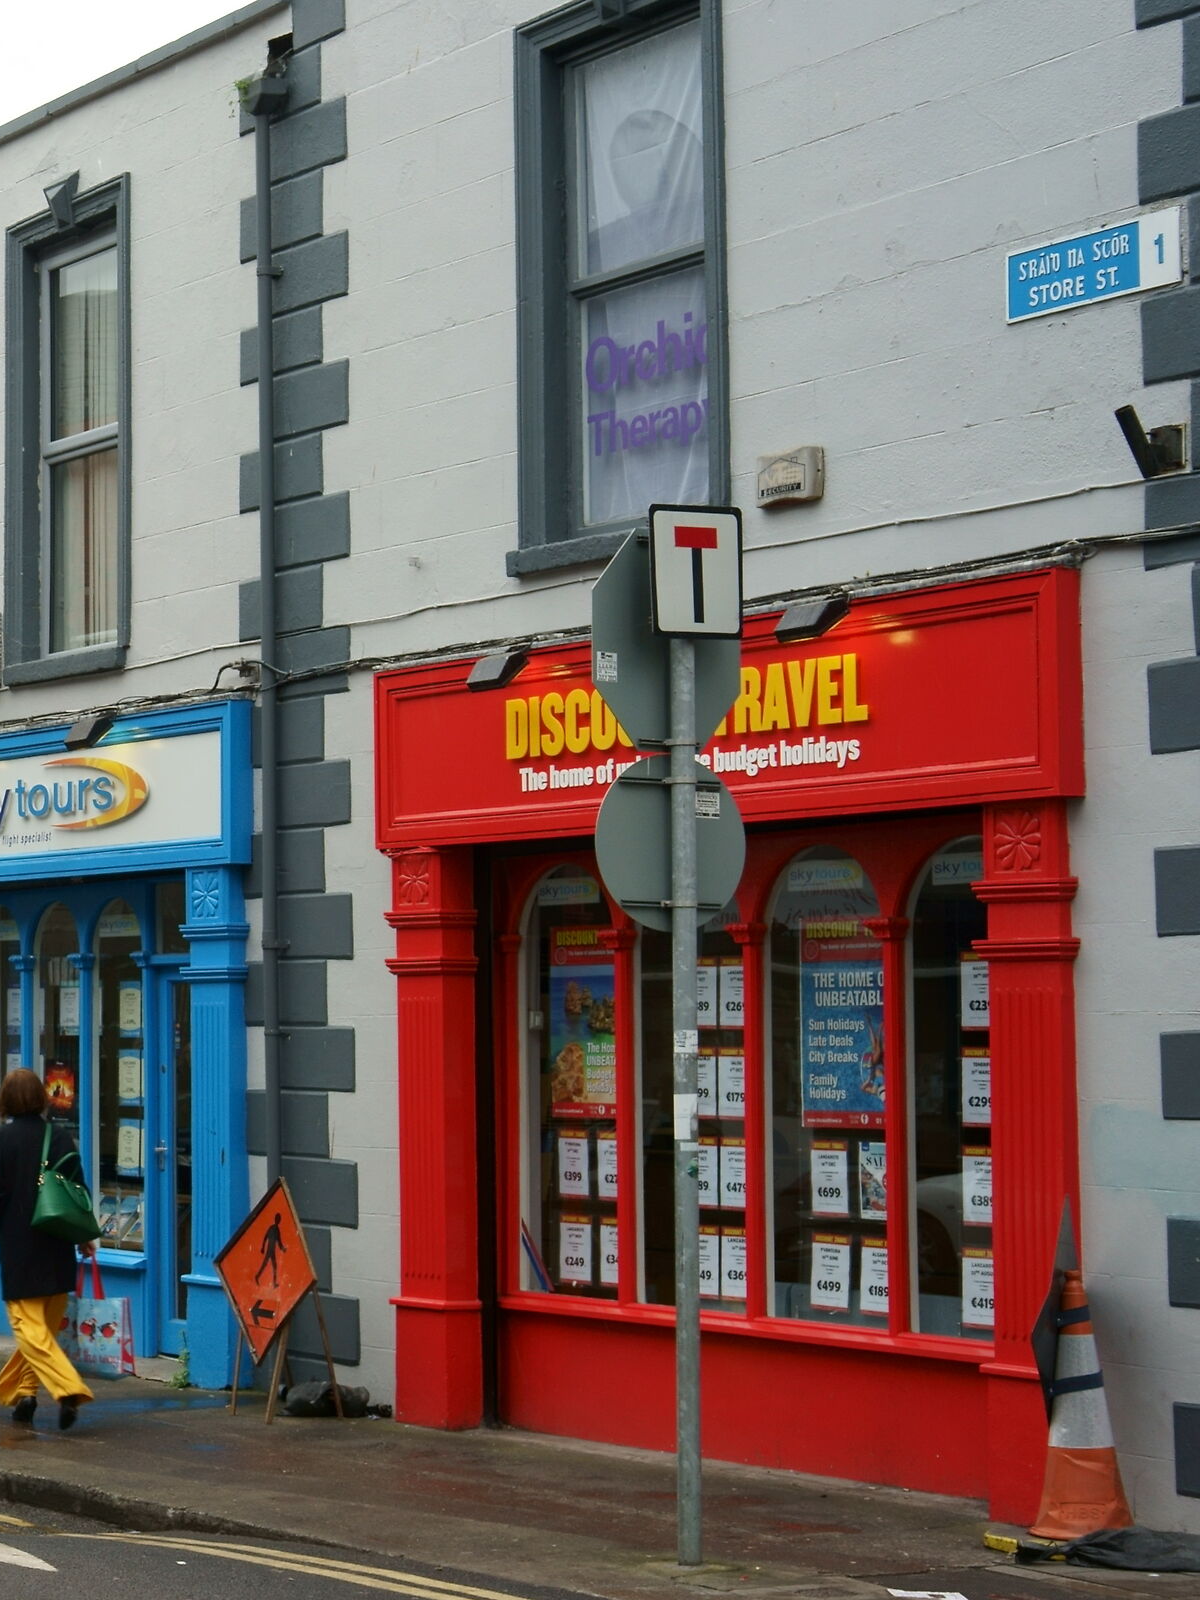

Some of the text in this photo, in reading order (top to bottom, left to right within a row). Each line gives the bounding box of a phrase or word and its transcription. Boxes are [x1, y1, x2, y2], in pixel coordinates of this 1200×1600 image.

[1154, 233, 1164, 264] 1
[1029, 266, 1120, 307] STORE ST.
[587, 398, 709, 457] Therap
[506, 652, 869, 760] DISCO RAVEL
[519, 766, 547, 792] The
[549, 764, 593, 789] home
[596, 758, 614, 784] of
[713, 743, 777, 777] budget
[780, 735, 860, 769] holidays
[2, 834, 19, 848] flight
[21, 832, 52, 846] specialist
[806, 921, 859, 939] DISCOUNT
[556, 930, 597, 946] DISCOUNT
[812, 971, 884, 988] THE HOME O
[815, 990, 884, 1007] UNBEATABL
[726, 1001, 744, 1012] €26
[969, 1000, 990, 1011] €23
[808, 1018, 864, 1032] Sun Holidays
[809, 1034, 853, 1047] Late Deals
[587, 1042, 616, 1053] The Hom
[587, 1055, 616, 1065] UNBEAT
[809, 1051, 858, 1064] City Breaks
[809, 1073, 838, 1088] Family
[697, 1088, 709, 1098] 99
[809, 1087, 846, 1101] Holidays
[865, 1156, 885, 1167] SAL
[564, 1171, 582, 1181] €399
[817, 1187, 841, 1198] €699
[565, 1256, 584, 1267] €249
[699, 1269, 712, 1280] 49
[727, 1269, 747, 1280] €36
[817, 1280, 841, 1292] €499
